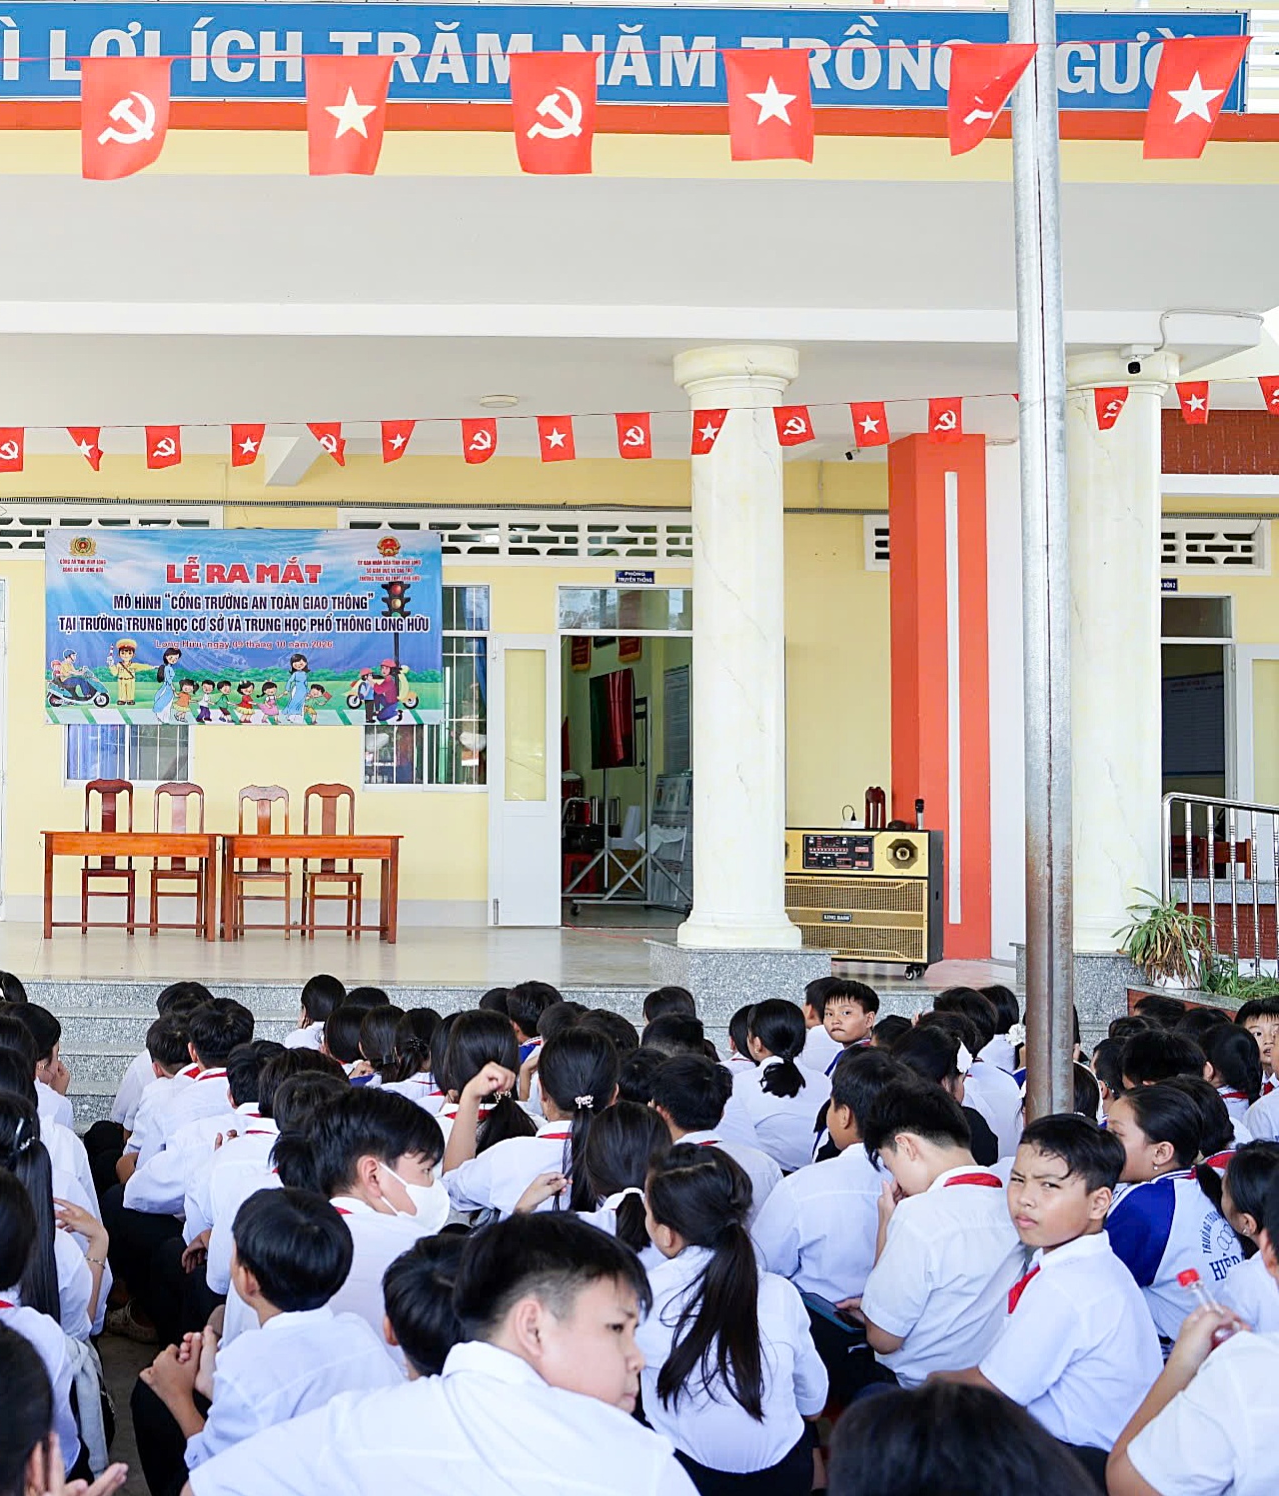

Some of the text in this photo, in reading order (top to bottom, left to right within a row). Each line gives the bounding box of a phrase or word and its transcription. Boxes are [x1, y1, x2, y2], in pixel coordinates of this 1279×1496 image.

[191, 16, 303, 83] ÍCH
[329, 21, 533, 83] TRĂM
[562, 23, 716, 87] NĂM
[166, 556, 322, 584] LỄ RA MẮT
[113, 594, 133, 610] MÔ
[135, 594, 161, 610] HÌNH
[205, 593, 248, 610] TRƯỜNG
[252, 596, 267, 610] AN
[271, 594, 299, 610] TOÀN
[303, 596, 328, 610] GIAO
[59, 613, 429, 636] TẠI TRƯỜNG TRUNG HỌC CƠ SỞ VÀ TRUNG HỌC PHỔ THÔNG LONG HỮU
[156, 640, 178, 650] Long
